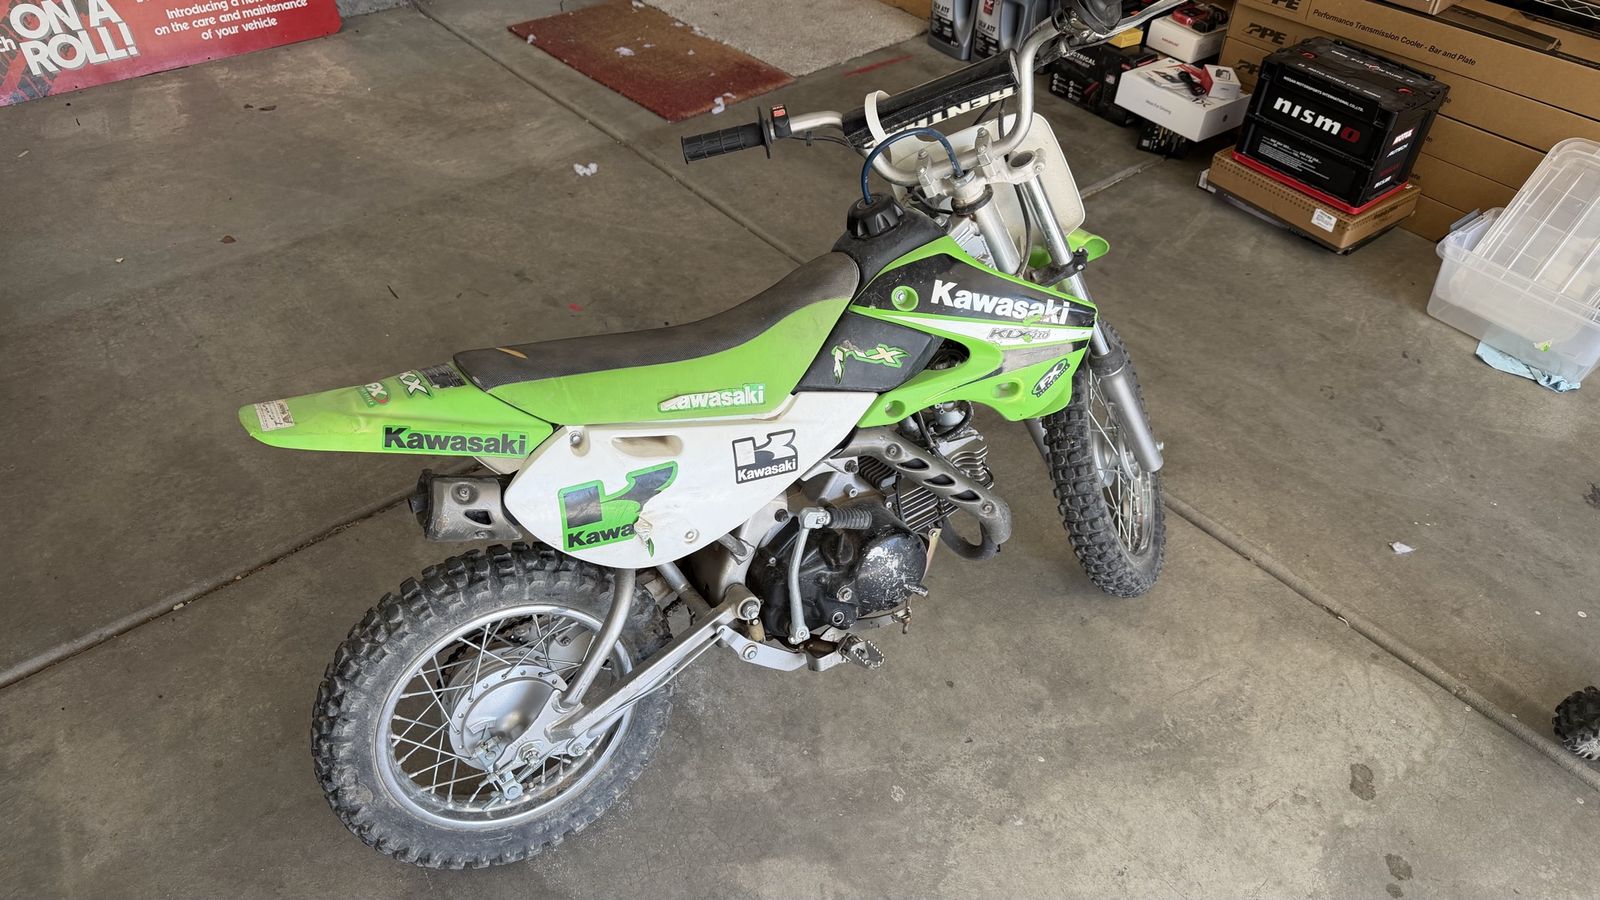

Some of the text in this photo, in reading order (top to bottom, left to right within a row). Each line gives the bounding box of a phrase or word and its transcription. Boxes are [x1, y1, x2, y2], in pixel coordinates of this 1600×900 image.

[10, 0, 122, 39] ON A
[154, 26, 171, 36] on
[172, 21, 190, 33] the
[192, 17, 217, 28] care
[219, 10, 241, 23] and
[242, 0, 308, 19] maintenance
[166, 0, 229, 20] Introducing
[201, 17, 278, 40] of your vehicle
[19, 22, 138, 76] ROLL!
[1313, 8, 1354, 27] Performance
[1355, 21, 1400, 42] Transmission
[1401, 36, 1424, 49] Cooler
[1428, 44, 1441, 56] Bar
[1442, 50, 1457, 60] and
[1457, 54, 1477, 66] Plate
[1273, 97, 1360, 143] nismo
[931, 279, 1071, 325] Kawasaki
[384, 427, 526, 455] Kawasaki
[738, 458, 796, 482] Kawasaki
